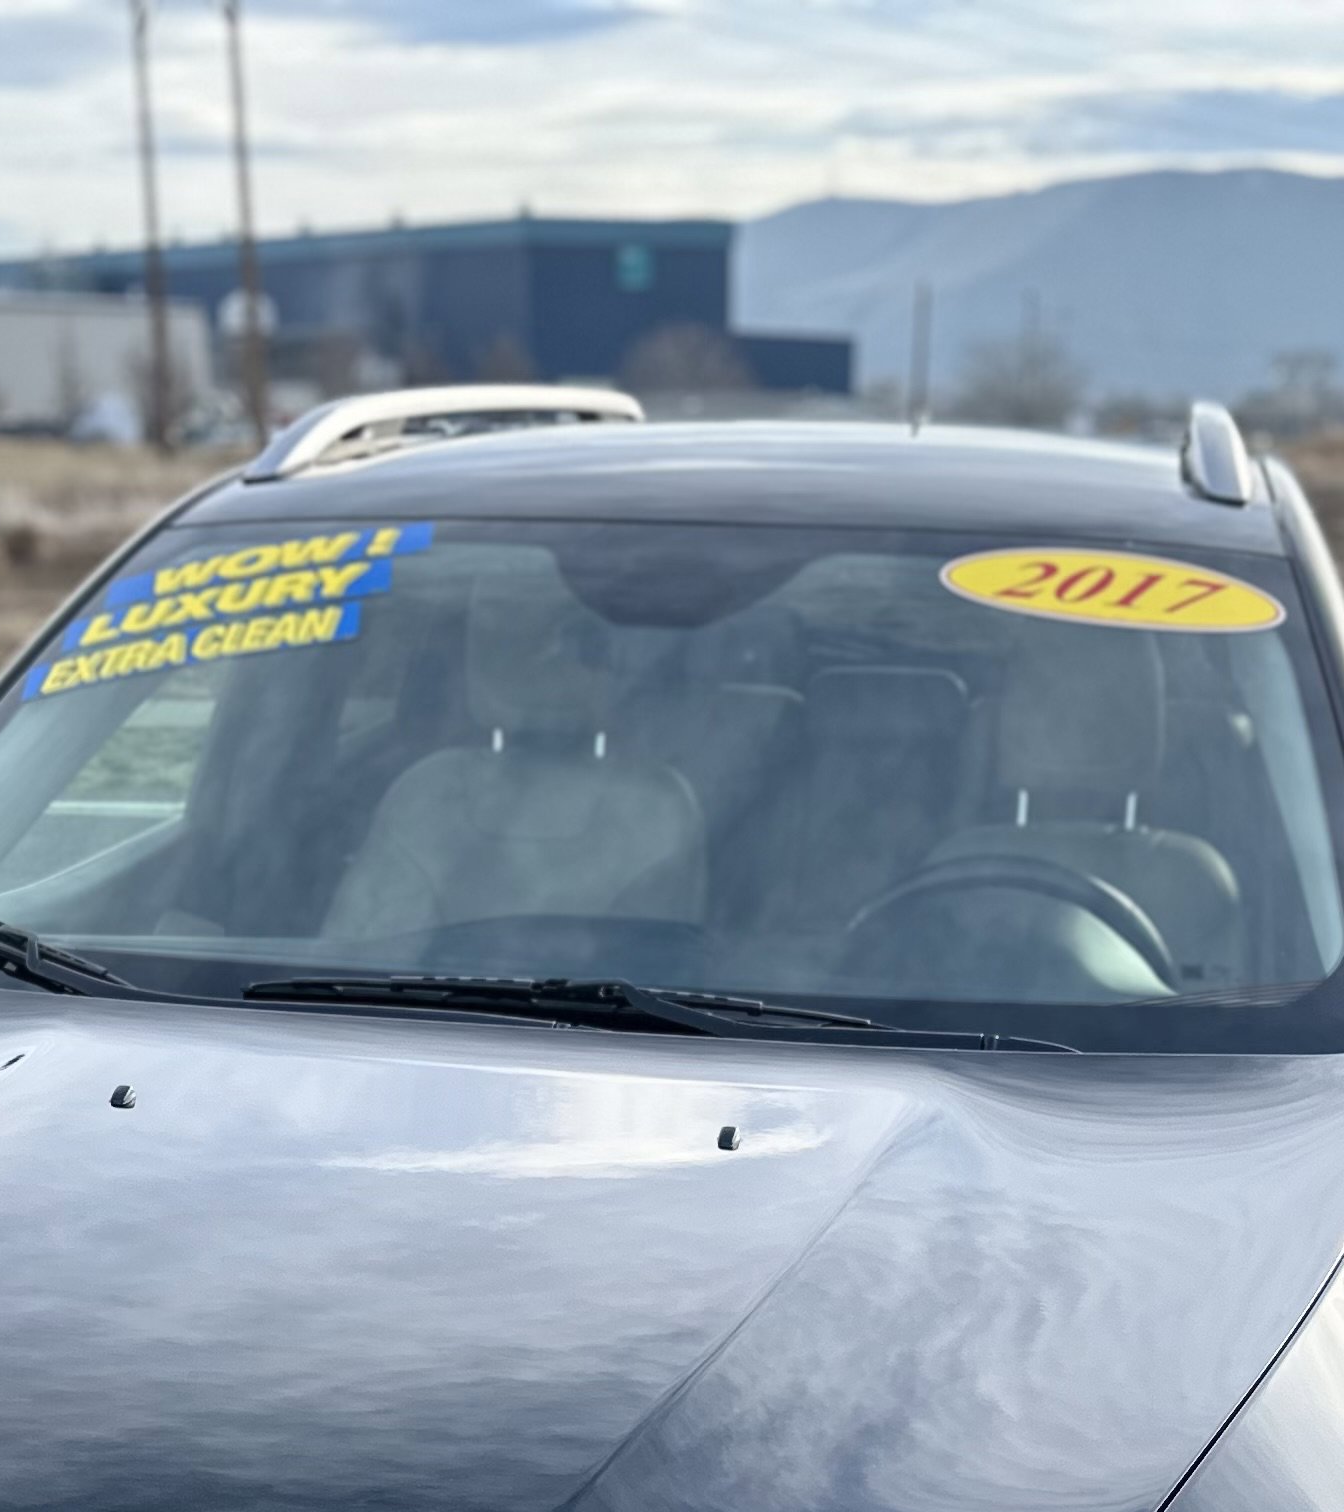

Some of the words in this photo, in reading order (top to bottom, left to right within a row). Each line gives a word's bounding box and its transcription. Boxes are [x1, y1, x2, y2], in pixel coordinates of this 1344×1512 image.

[154, 532, 359, 594] WOW
[995, 561, 1228, 614] 2017
[79, 562, 371, 646] LUXURY
[41, 633, 187, 694] EXTRA
[191, 606, 343, 659] CLEAN
